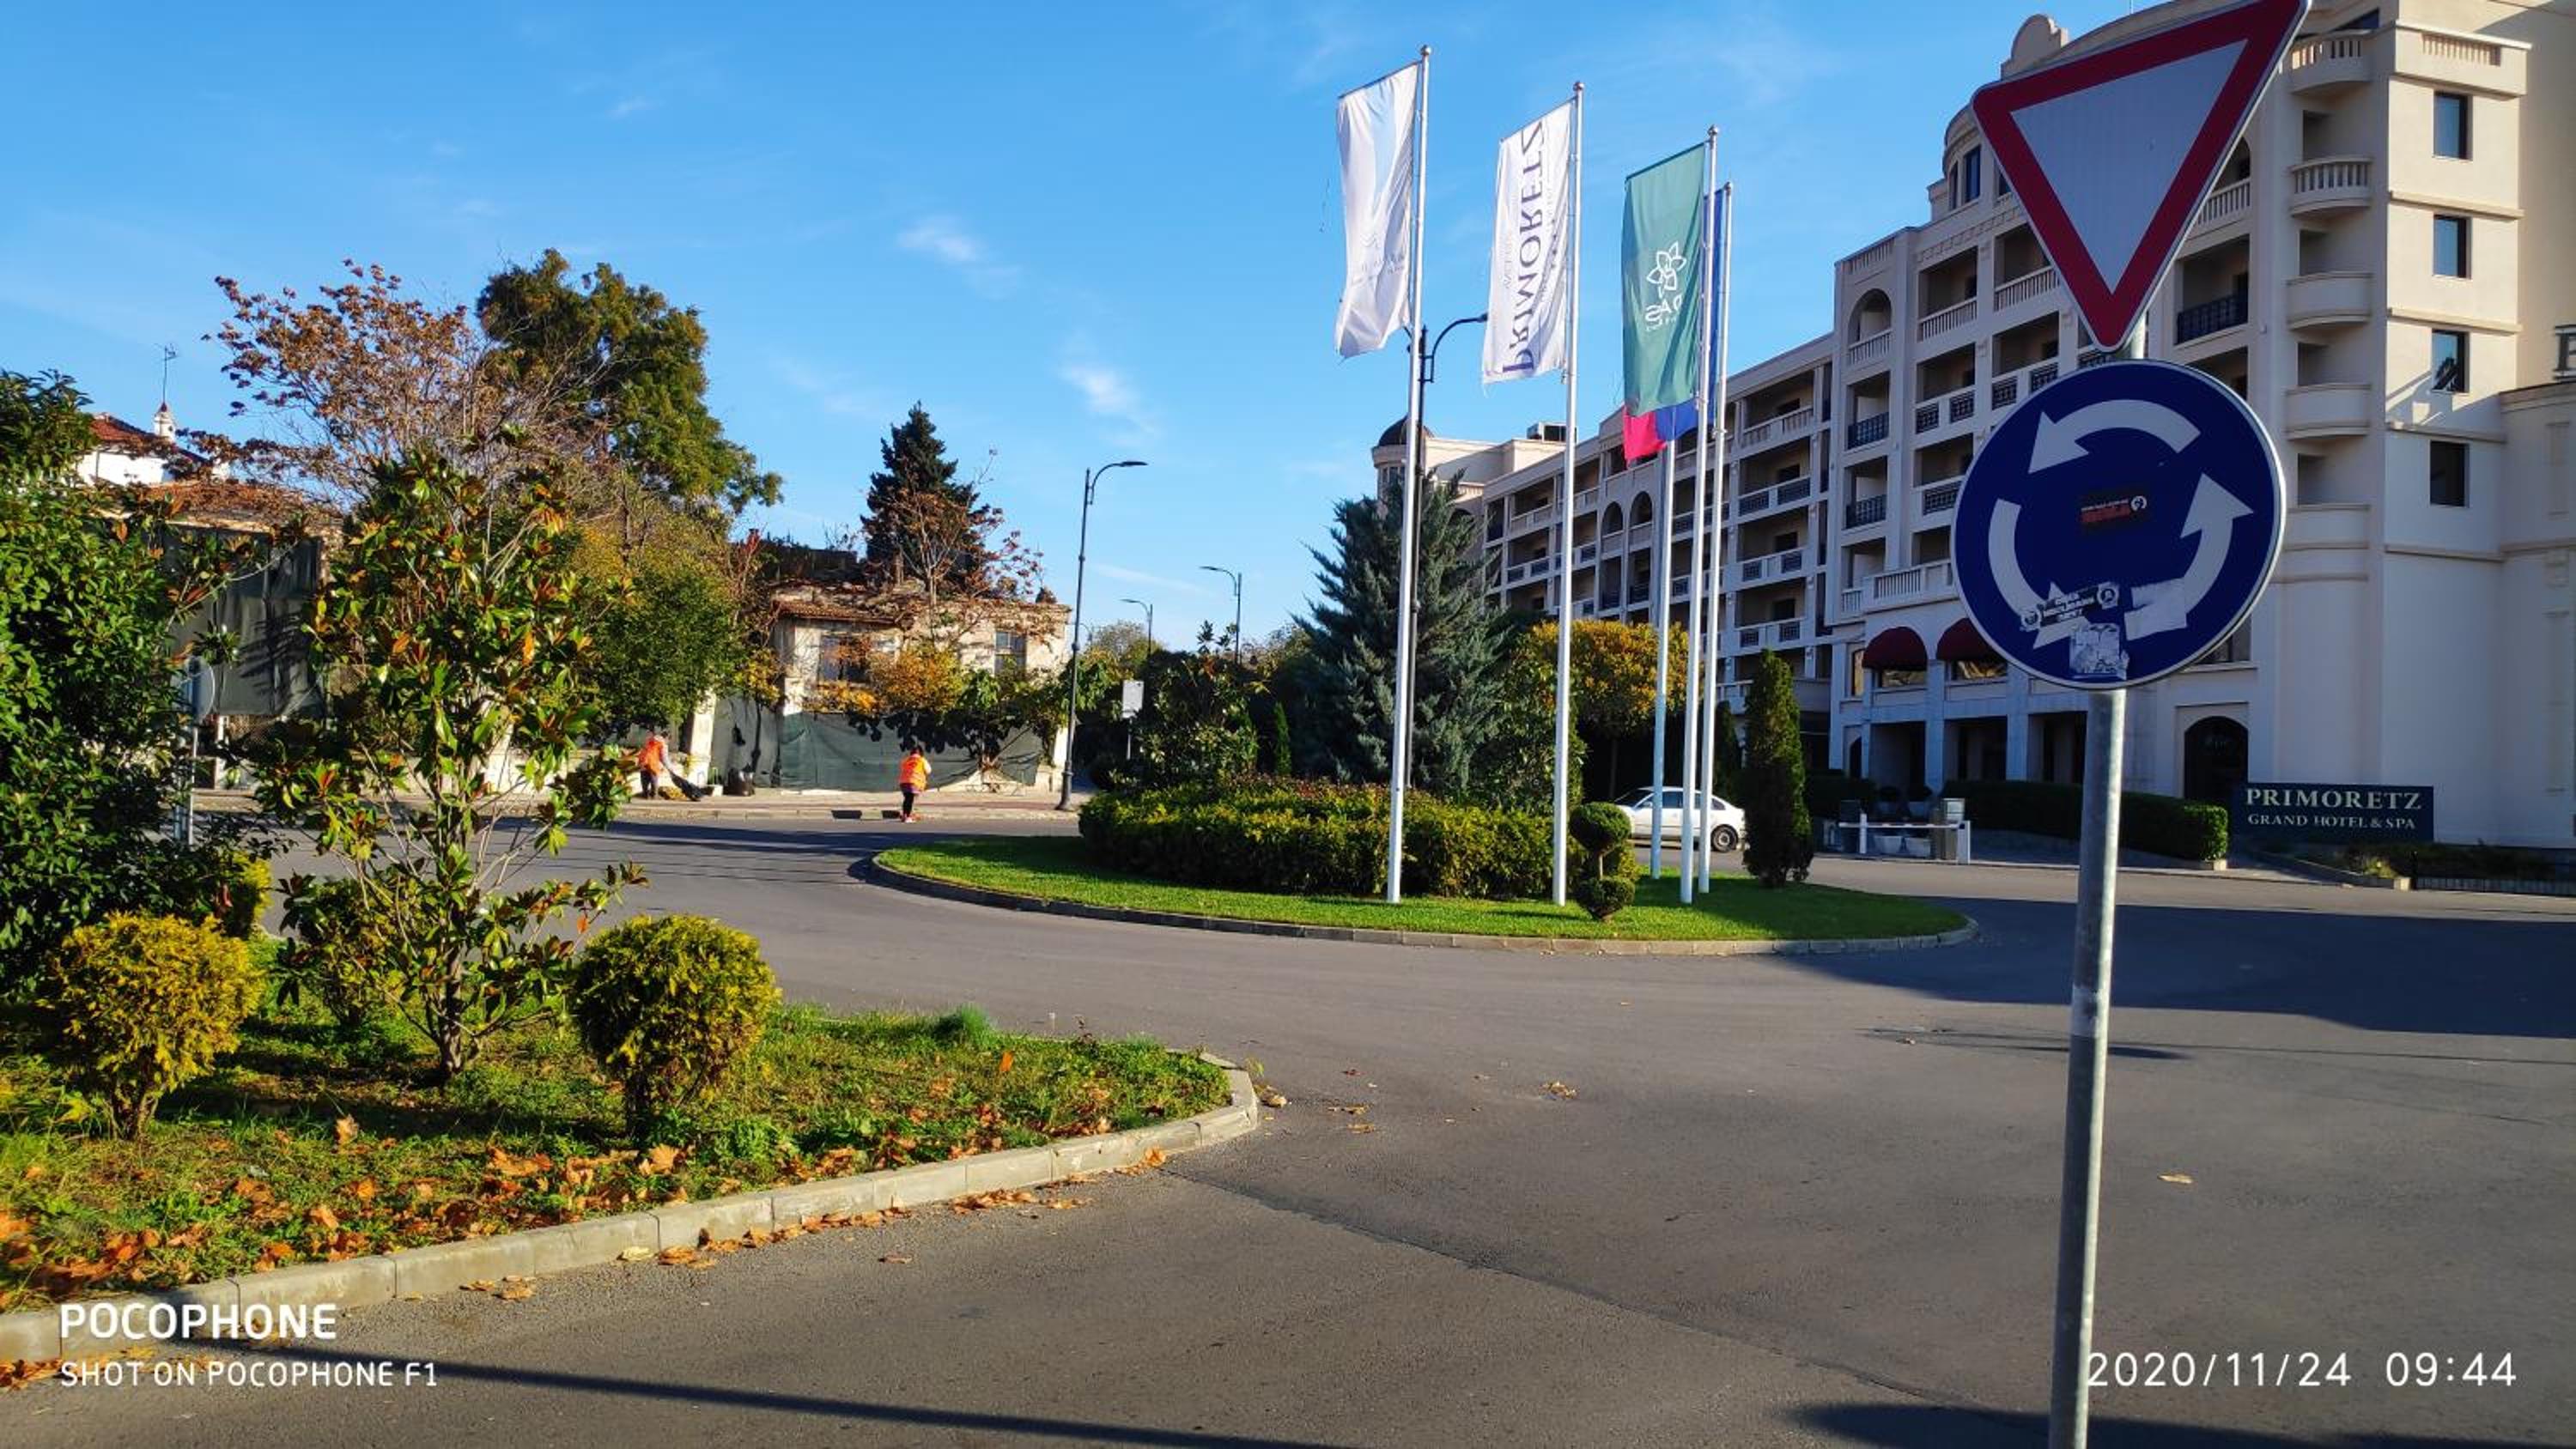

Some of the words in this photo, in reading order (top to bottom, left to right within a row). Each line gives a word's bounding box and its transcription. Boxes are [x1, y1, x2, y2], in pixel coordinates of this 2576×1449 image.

[2246, 788, 2421, 810] PRIMORETZ
[2247, 814, 2308, 827] GRAND
[2314, 815, 2367, 828] HOTEL
[2385, 818, 2415, 830] SPA
